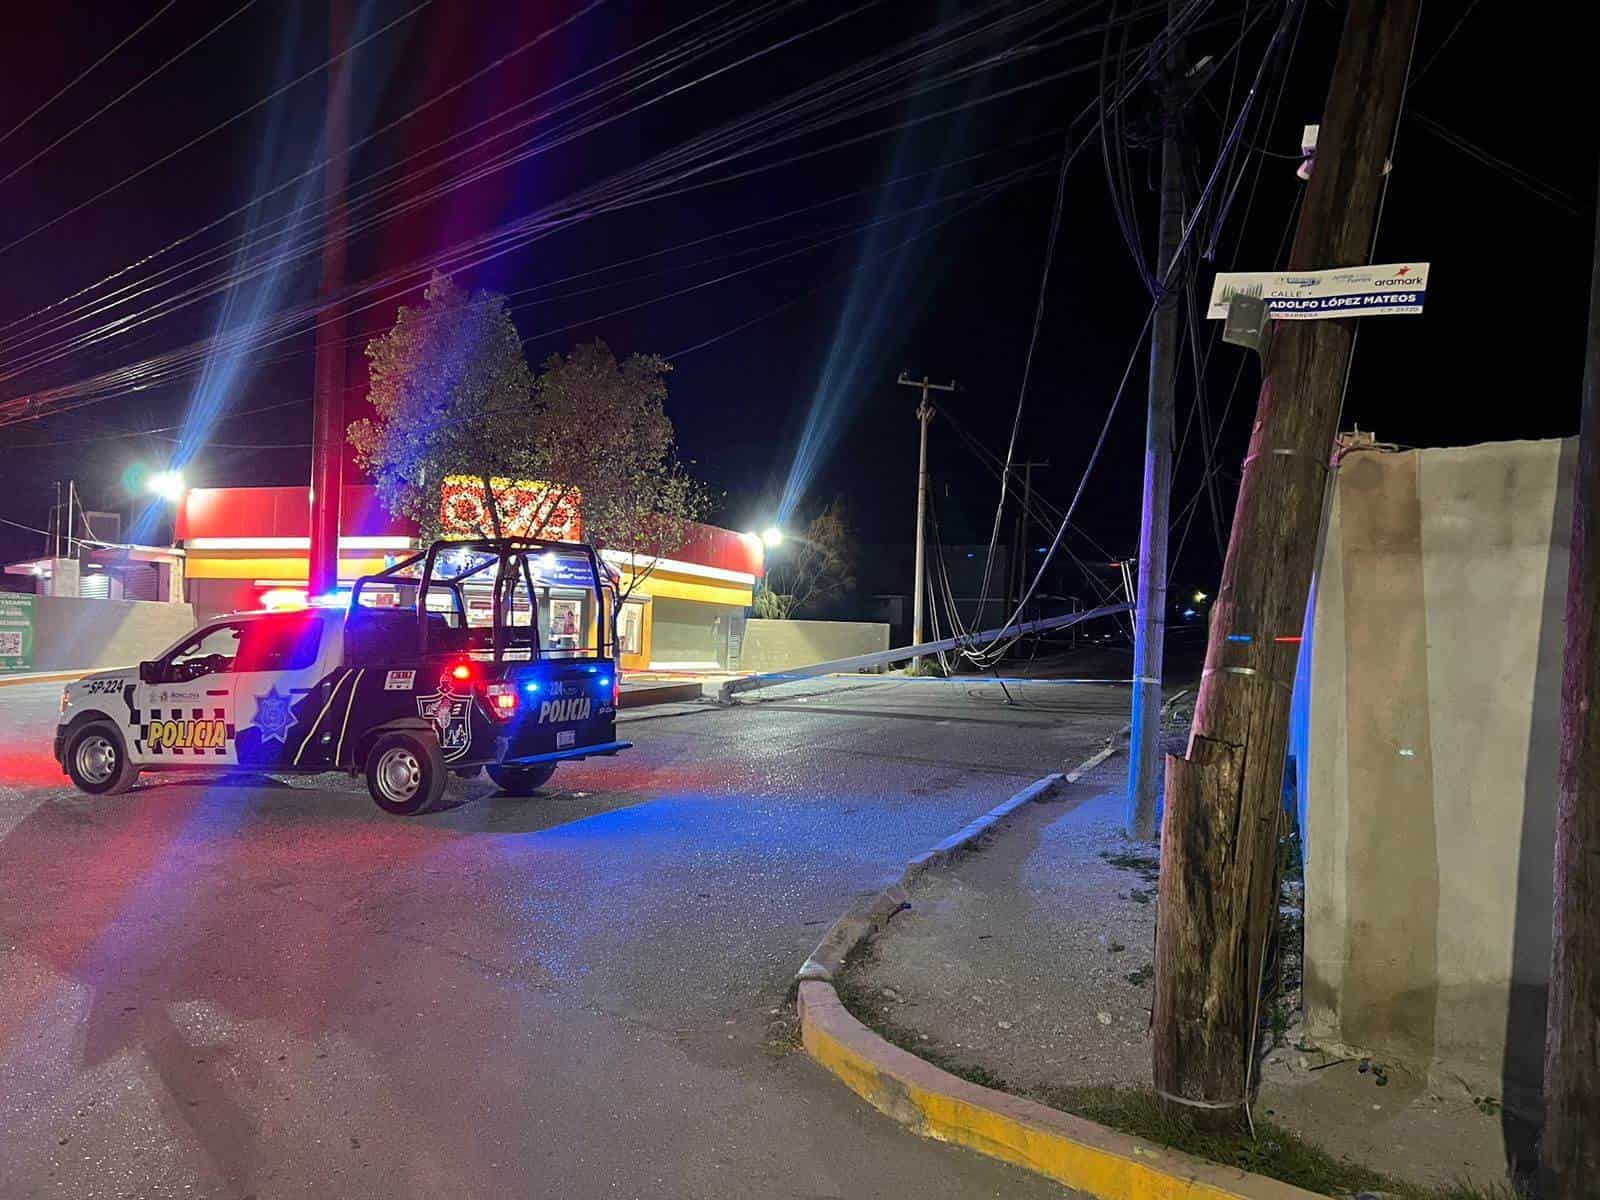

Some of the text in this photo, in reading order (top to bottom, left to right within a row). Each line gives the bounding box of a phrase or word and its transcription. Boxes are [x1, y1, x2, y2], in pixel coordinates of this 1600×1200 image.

[1374, 277, 1423, 287] aramark
[1269, 294, 1417, 309] ADOLFO LÓPEZ MATEOS
[88, 680, 124, 694] SP-224
[147, 720, 227, 749] POLICIA
